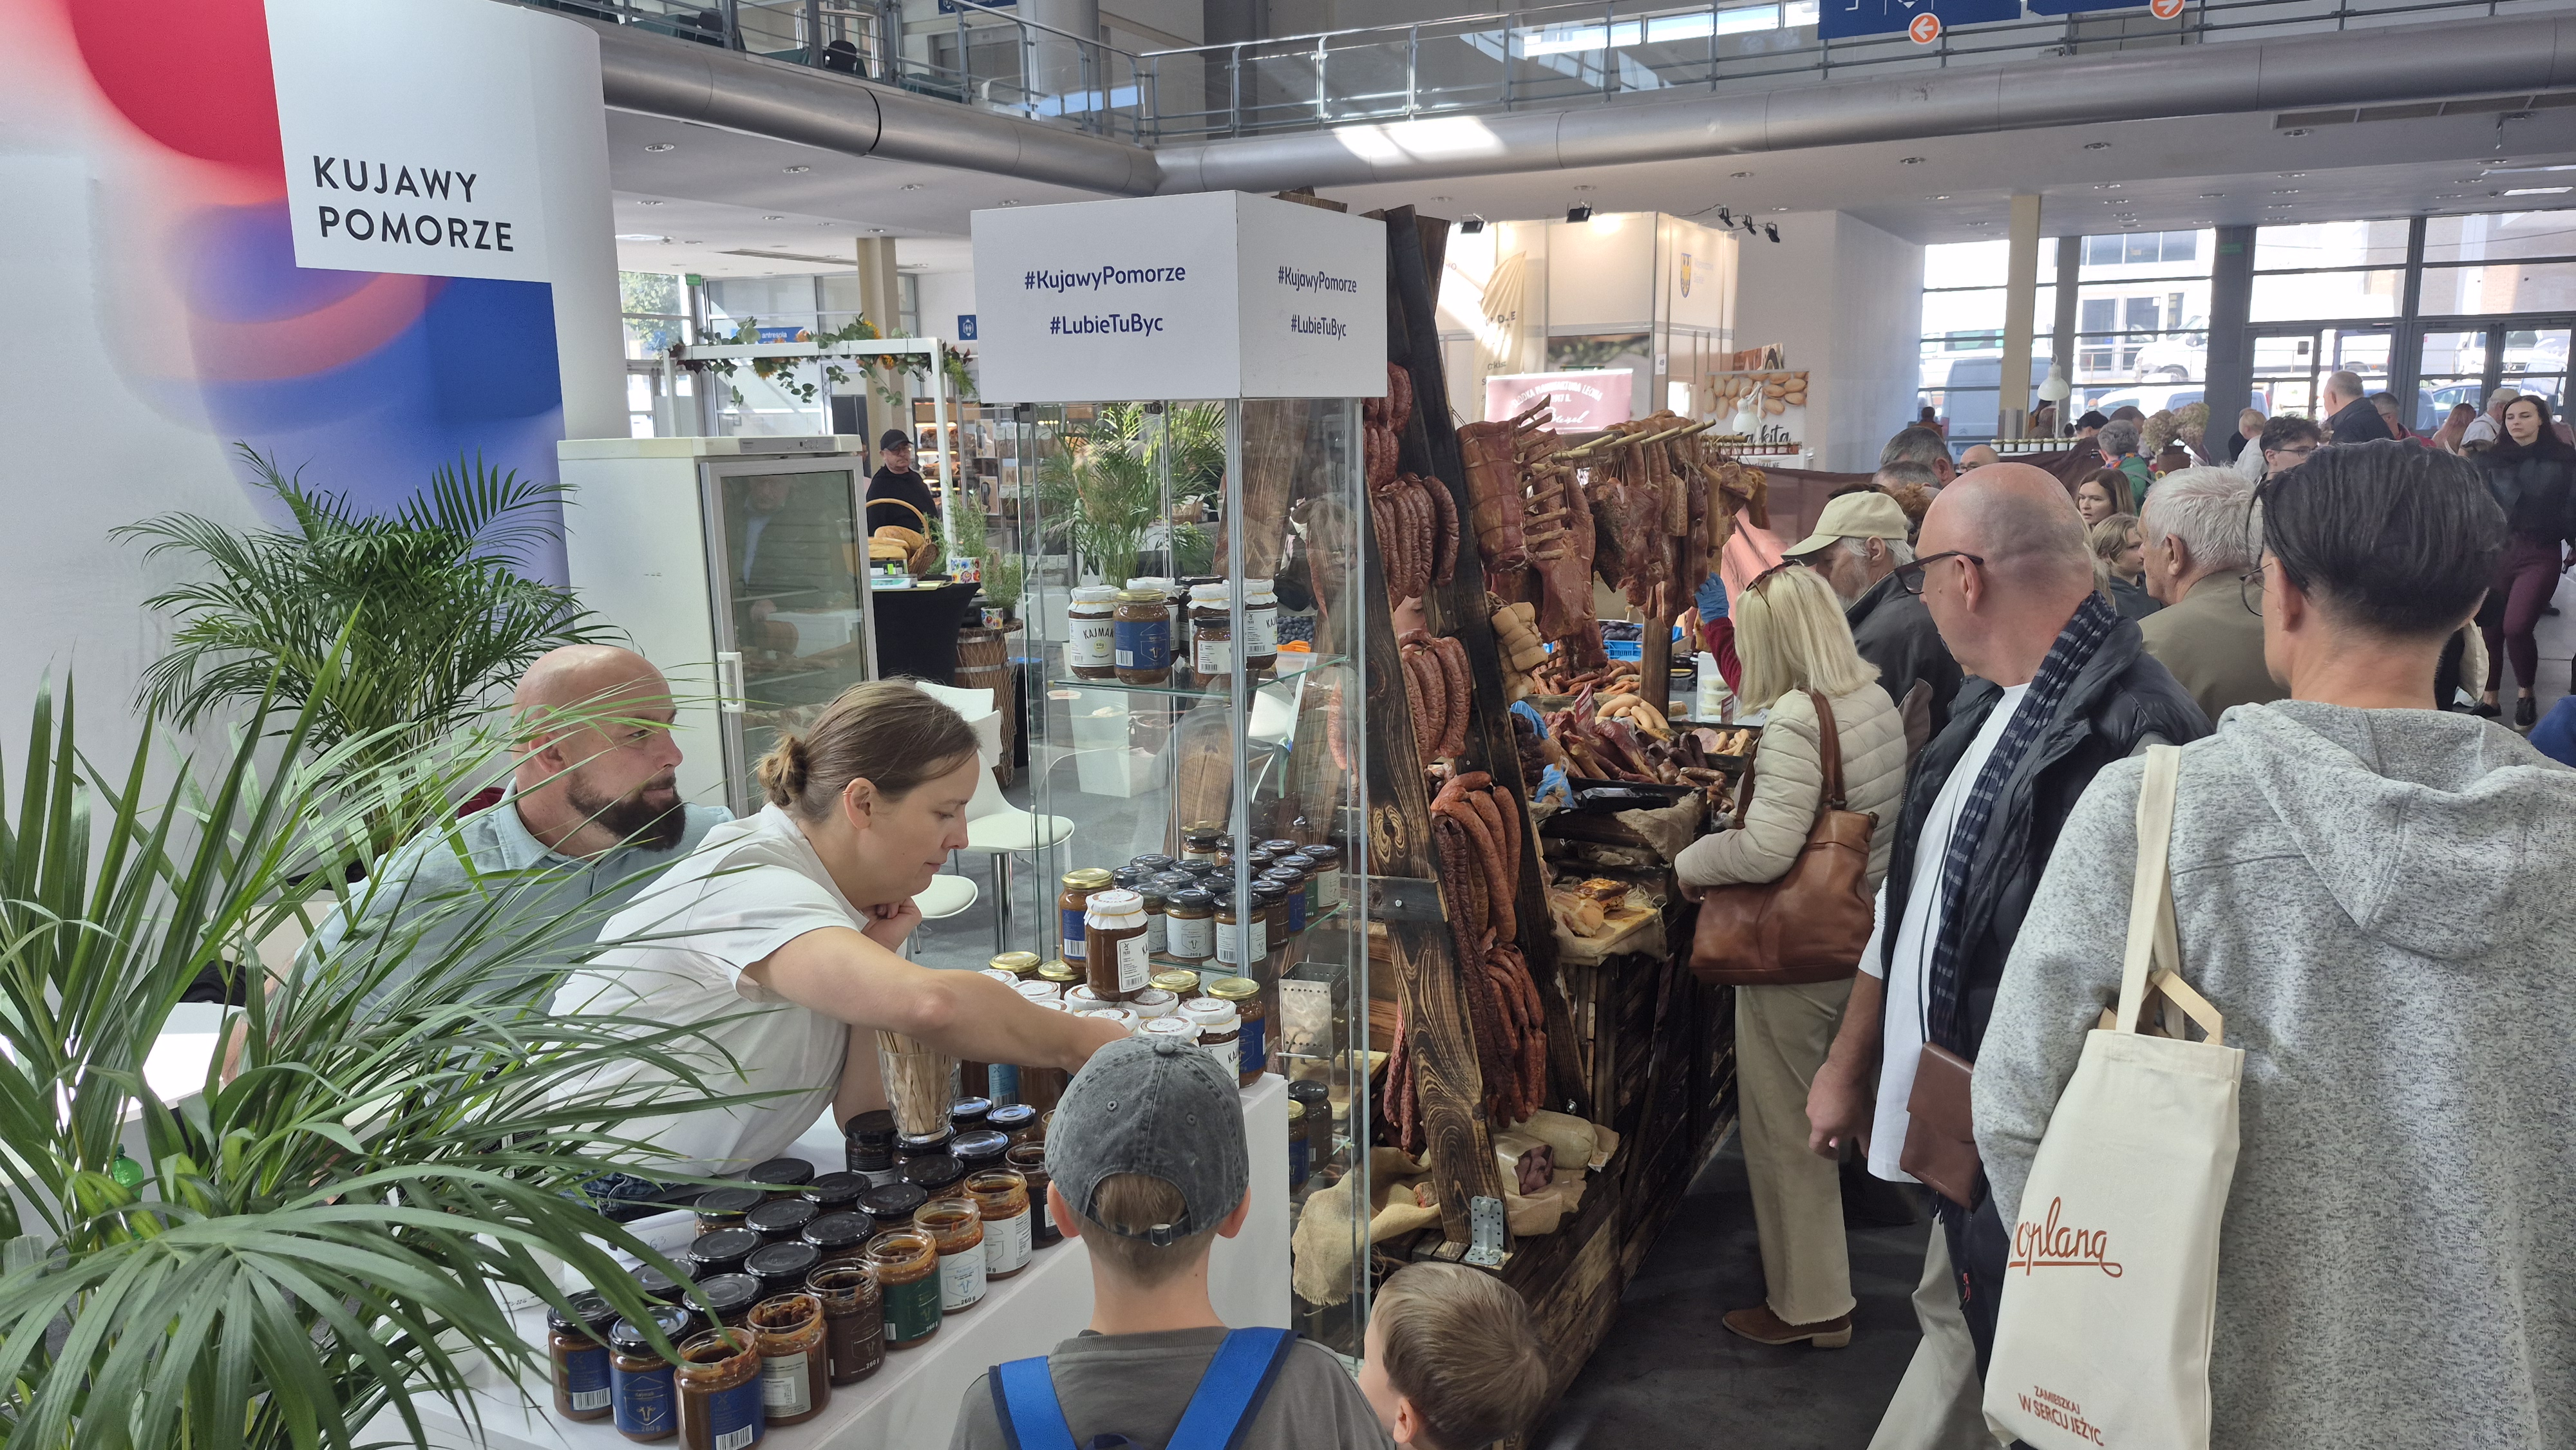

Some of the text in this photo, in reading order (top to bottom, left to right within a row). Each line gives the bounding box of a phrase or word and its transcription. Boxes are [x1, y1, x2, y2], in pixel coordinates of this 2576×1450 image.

[313, 155, 477, 202] KUJAWY
[319, 205, 513, 252] POMORZE
[1025, 266, 1186, 293] #KujawyPomorze
[1278, 265, 1357, 294] #KujawyPomorze
[1050, 313, 1163, 337] #LubieTuByc
[1291, 314, 1347, 341] #LubieTuByc
[926, 1322, 935, 1332] 260
[866, 1359, 876, 1369] 260
[2018, 1393, 2031, 1413] W
[2033, 1399, 2069, 1430] SERCU
[2034, 1385, 2080, 1415] ZAMIESZKAJ
